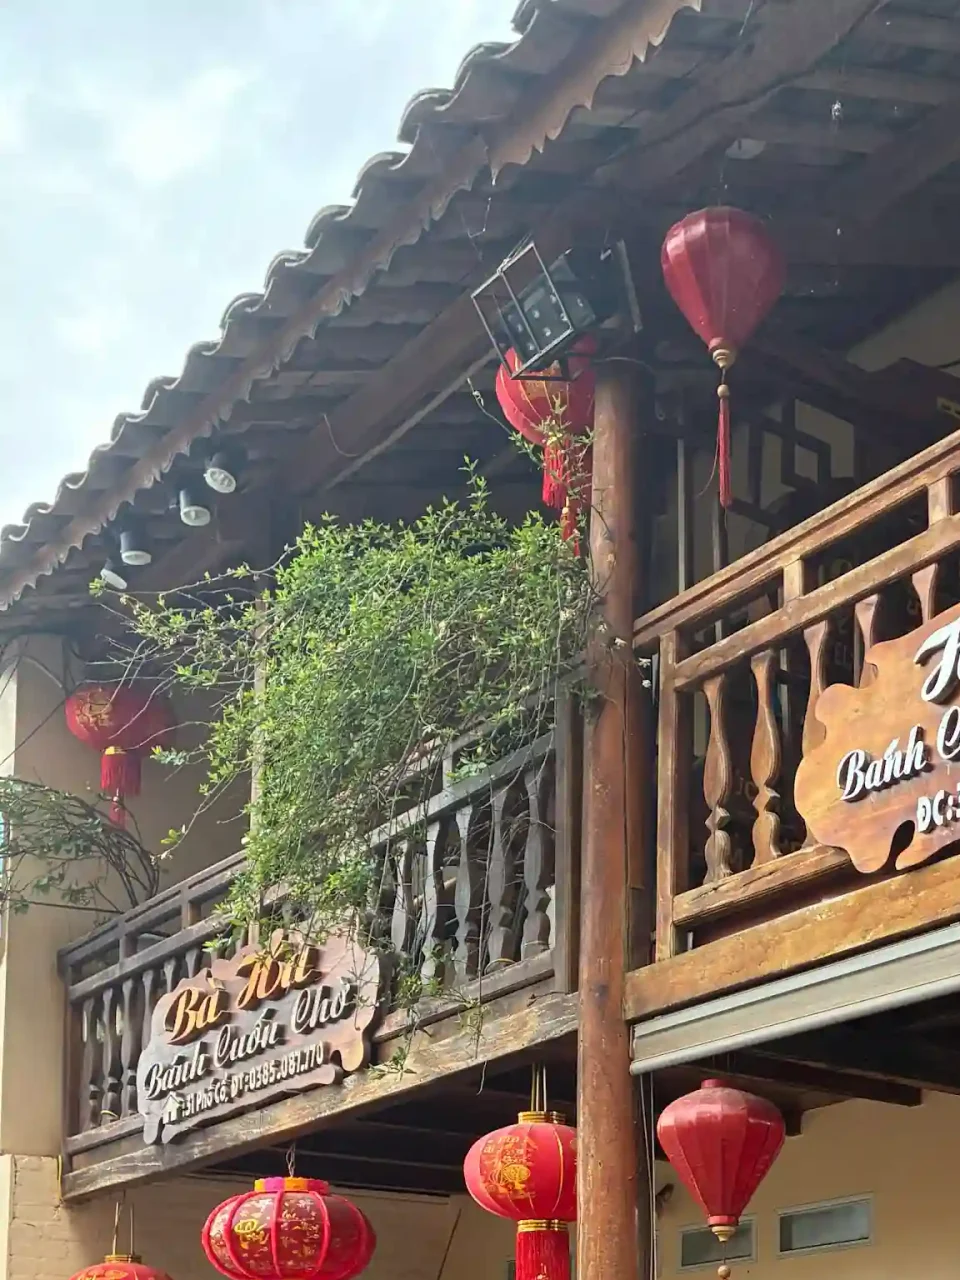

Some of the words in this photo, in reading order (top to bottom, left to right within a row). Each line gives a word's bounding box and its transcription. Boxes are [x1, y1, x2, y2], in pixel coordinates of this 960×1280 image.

[163, 977, 223, 1045] Bà
[144, 1041, 210, 1099] Bánh
[213, 1008, 284, 1068] Cuốn
